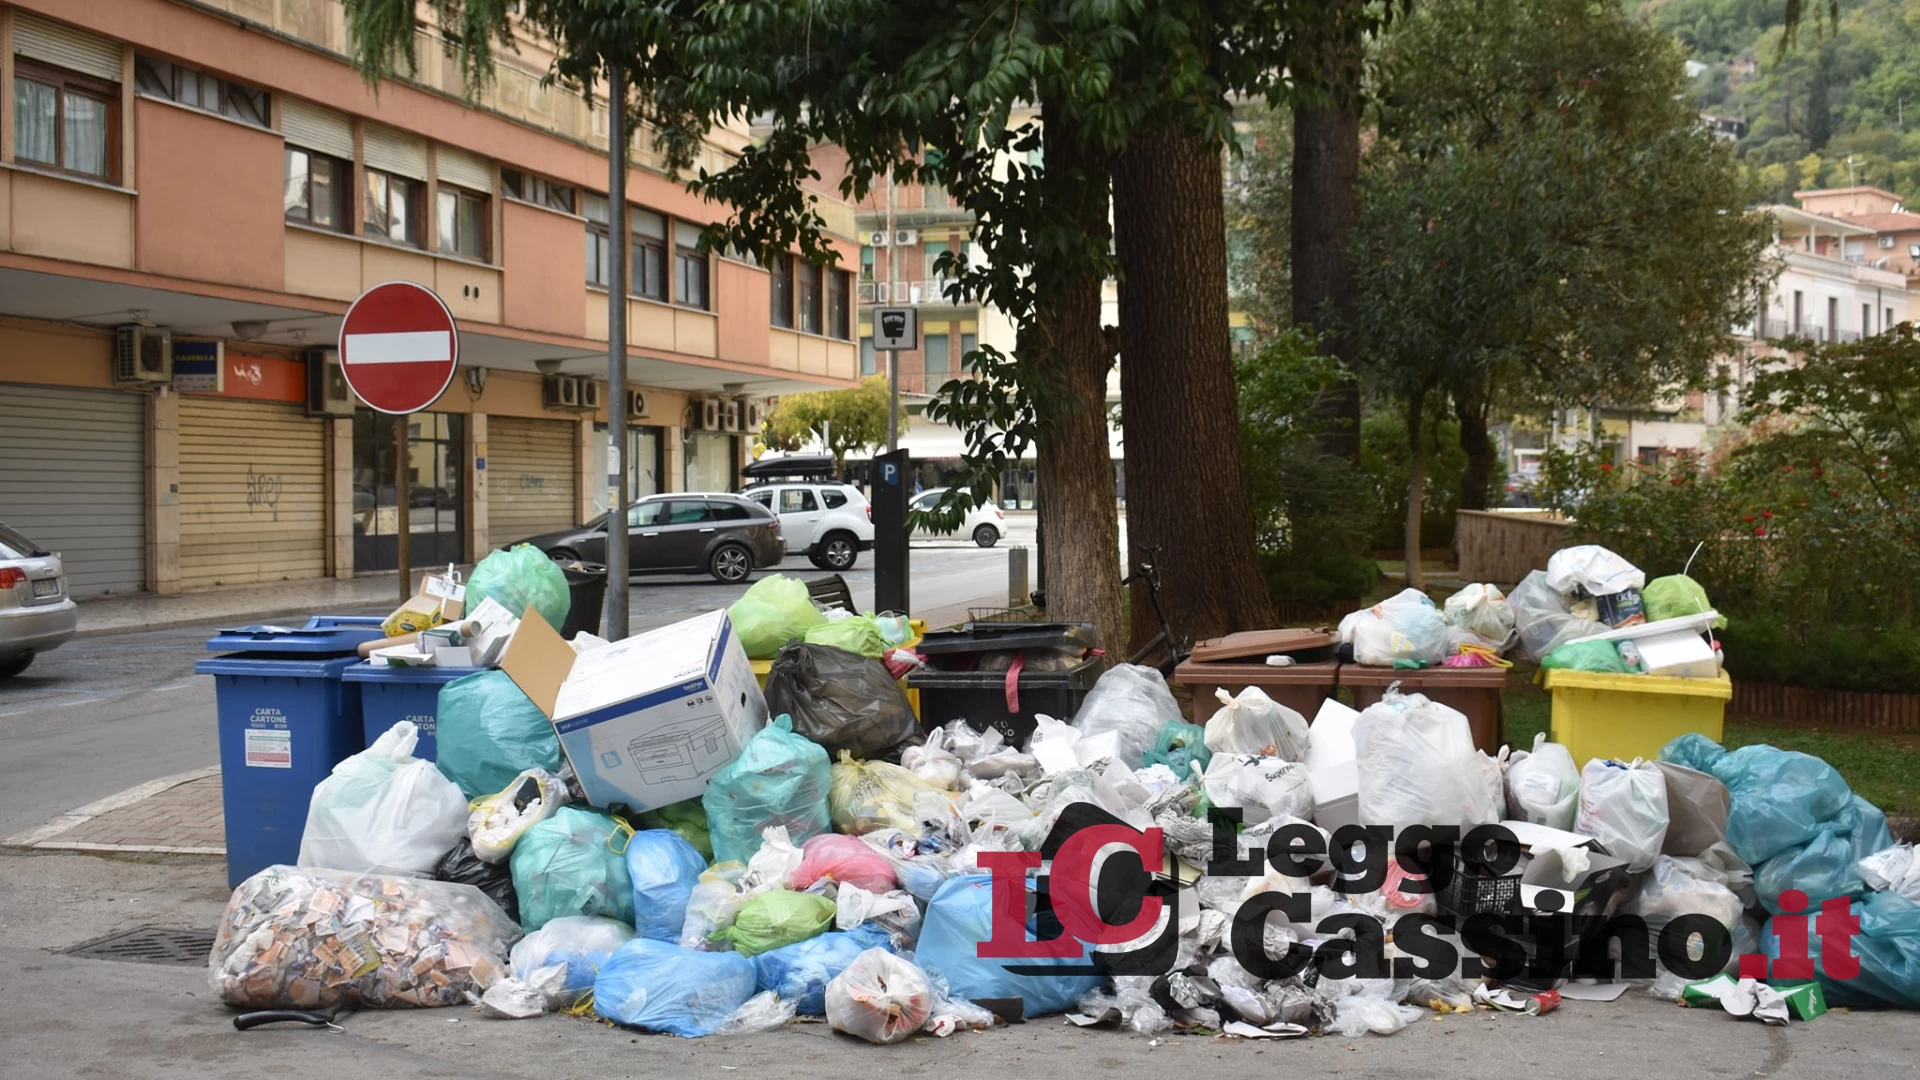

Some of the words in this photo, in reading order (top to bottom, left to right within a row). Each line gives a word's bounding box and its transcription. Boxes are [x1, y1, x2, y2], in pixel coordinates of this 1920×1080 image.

[884, 463, 896, 481] P
[255, 708, 281, 716] CARTA
[250, 715, 287, 724] CARTONE
[406, 715, 435, 723] CARTA
